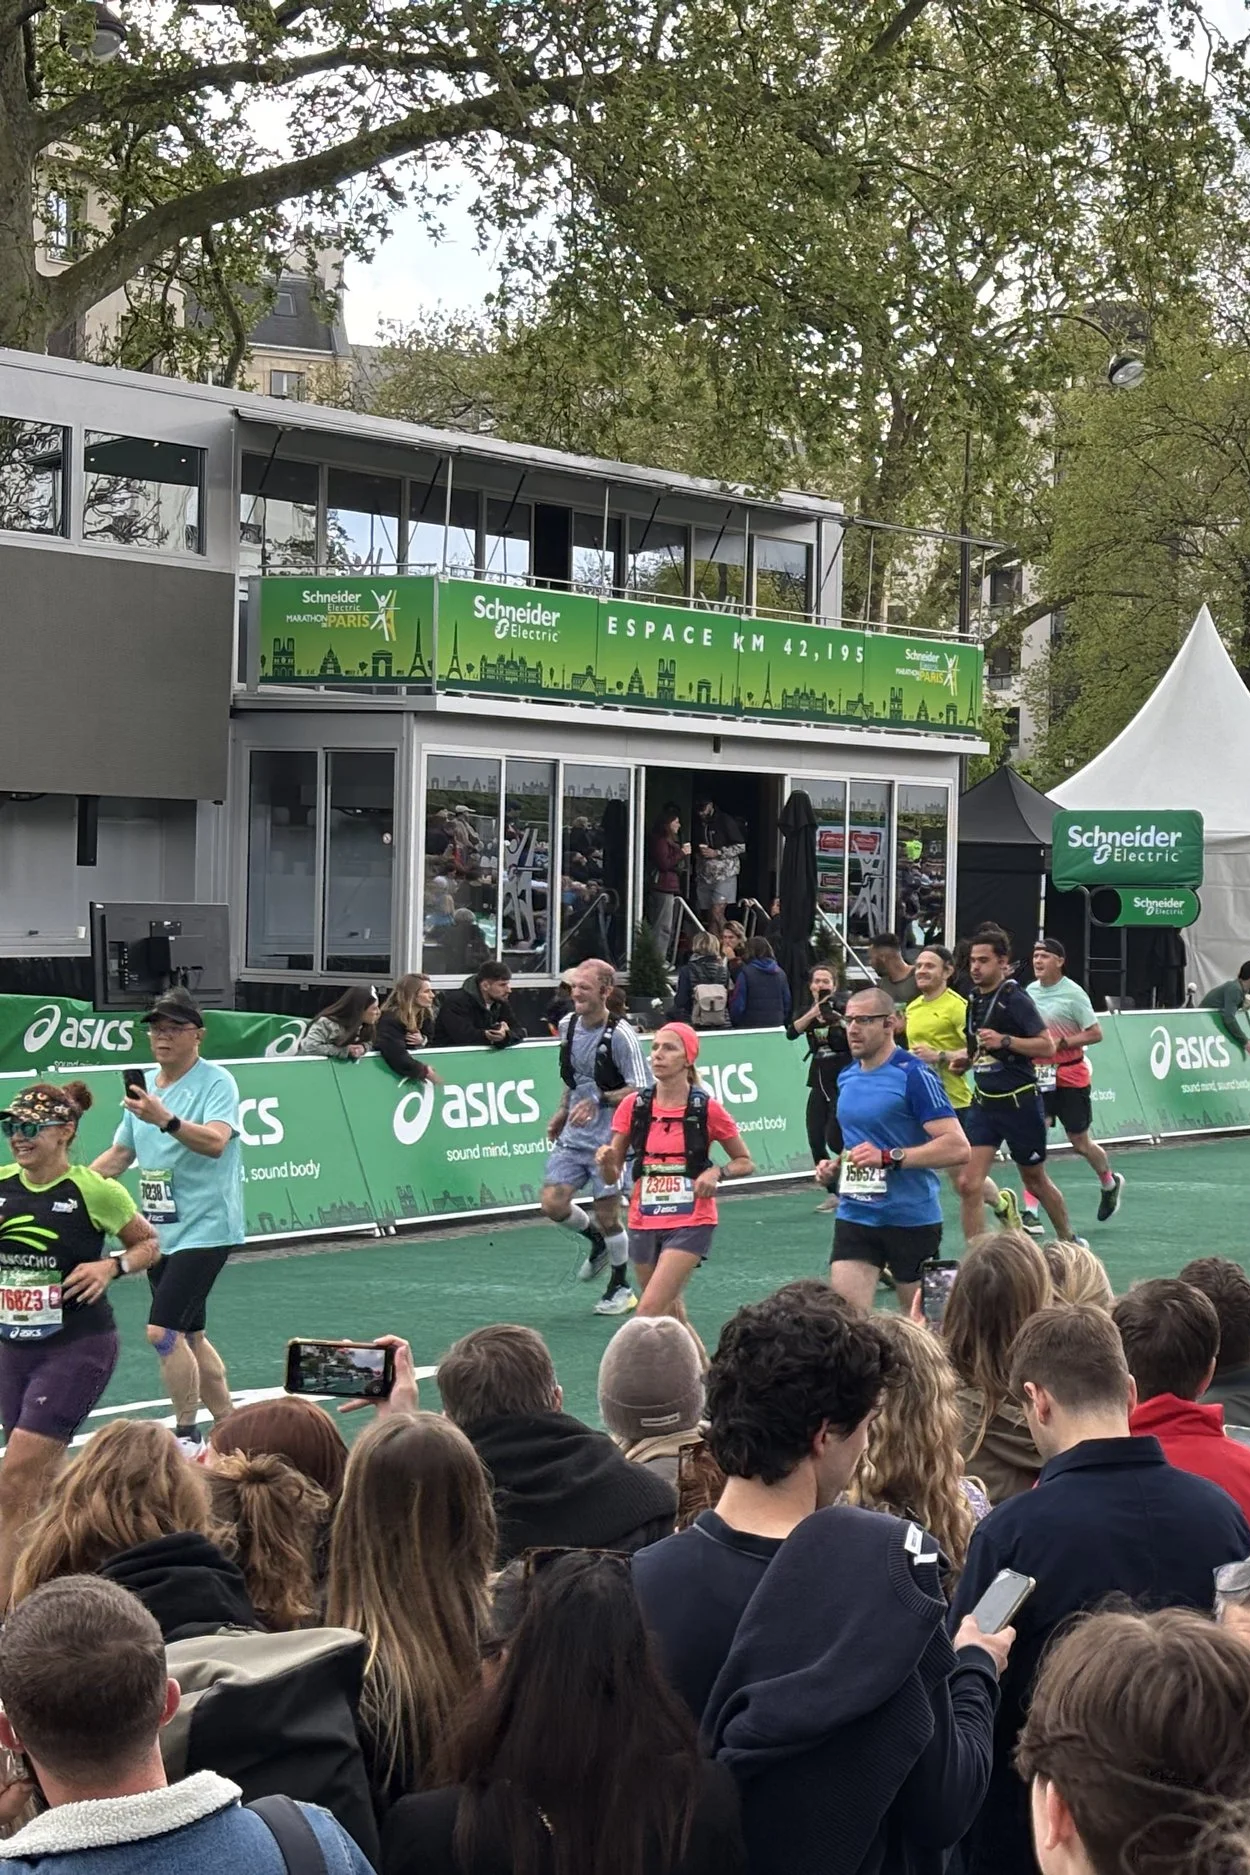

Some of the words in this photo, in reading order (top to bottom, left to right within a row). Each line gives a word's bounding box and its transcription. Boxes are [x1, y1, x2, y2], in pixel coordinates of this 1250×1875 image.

[302, 590, 362, 603] Schneider
[286, 614, 328, 623] MARATHON
[327, 604, 360, 612] Electric
[473, 594, 561, 628] Schneider
[328, 614, 370, 628] PARIS
[510, 623, 560, 644] Electric
[607, 615, 713, 647] ESPACE
[733, 632, 764, 653] KM
[784, 637, 864, 663] 42,195
[905, 648, 940, 663] Schneider
[1068, 824, 1182, 848] Schneider
[1114, 848, 1180, 863] Electric
[1133, 896, 1185, 910] Schneider
[60, 1017, 133, 1051] asics
[1175, 1035, 1230, 1069] asics
[697, 1063, 758, 1105] SICS
[442, 1079, 540, 1129] asics
[764, 1114, 787, 1131] body
[446, 1143, 480, 1161] sound
[482, 1140, 512, 1158] mind,
[512, 1138, 545, 1155] sound
[251, 1161, 288, 1180] sound
[289, 1159, 321, 1179] body
[646, 1176, 681, 1194] 23205
